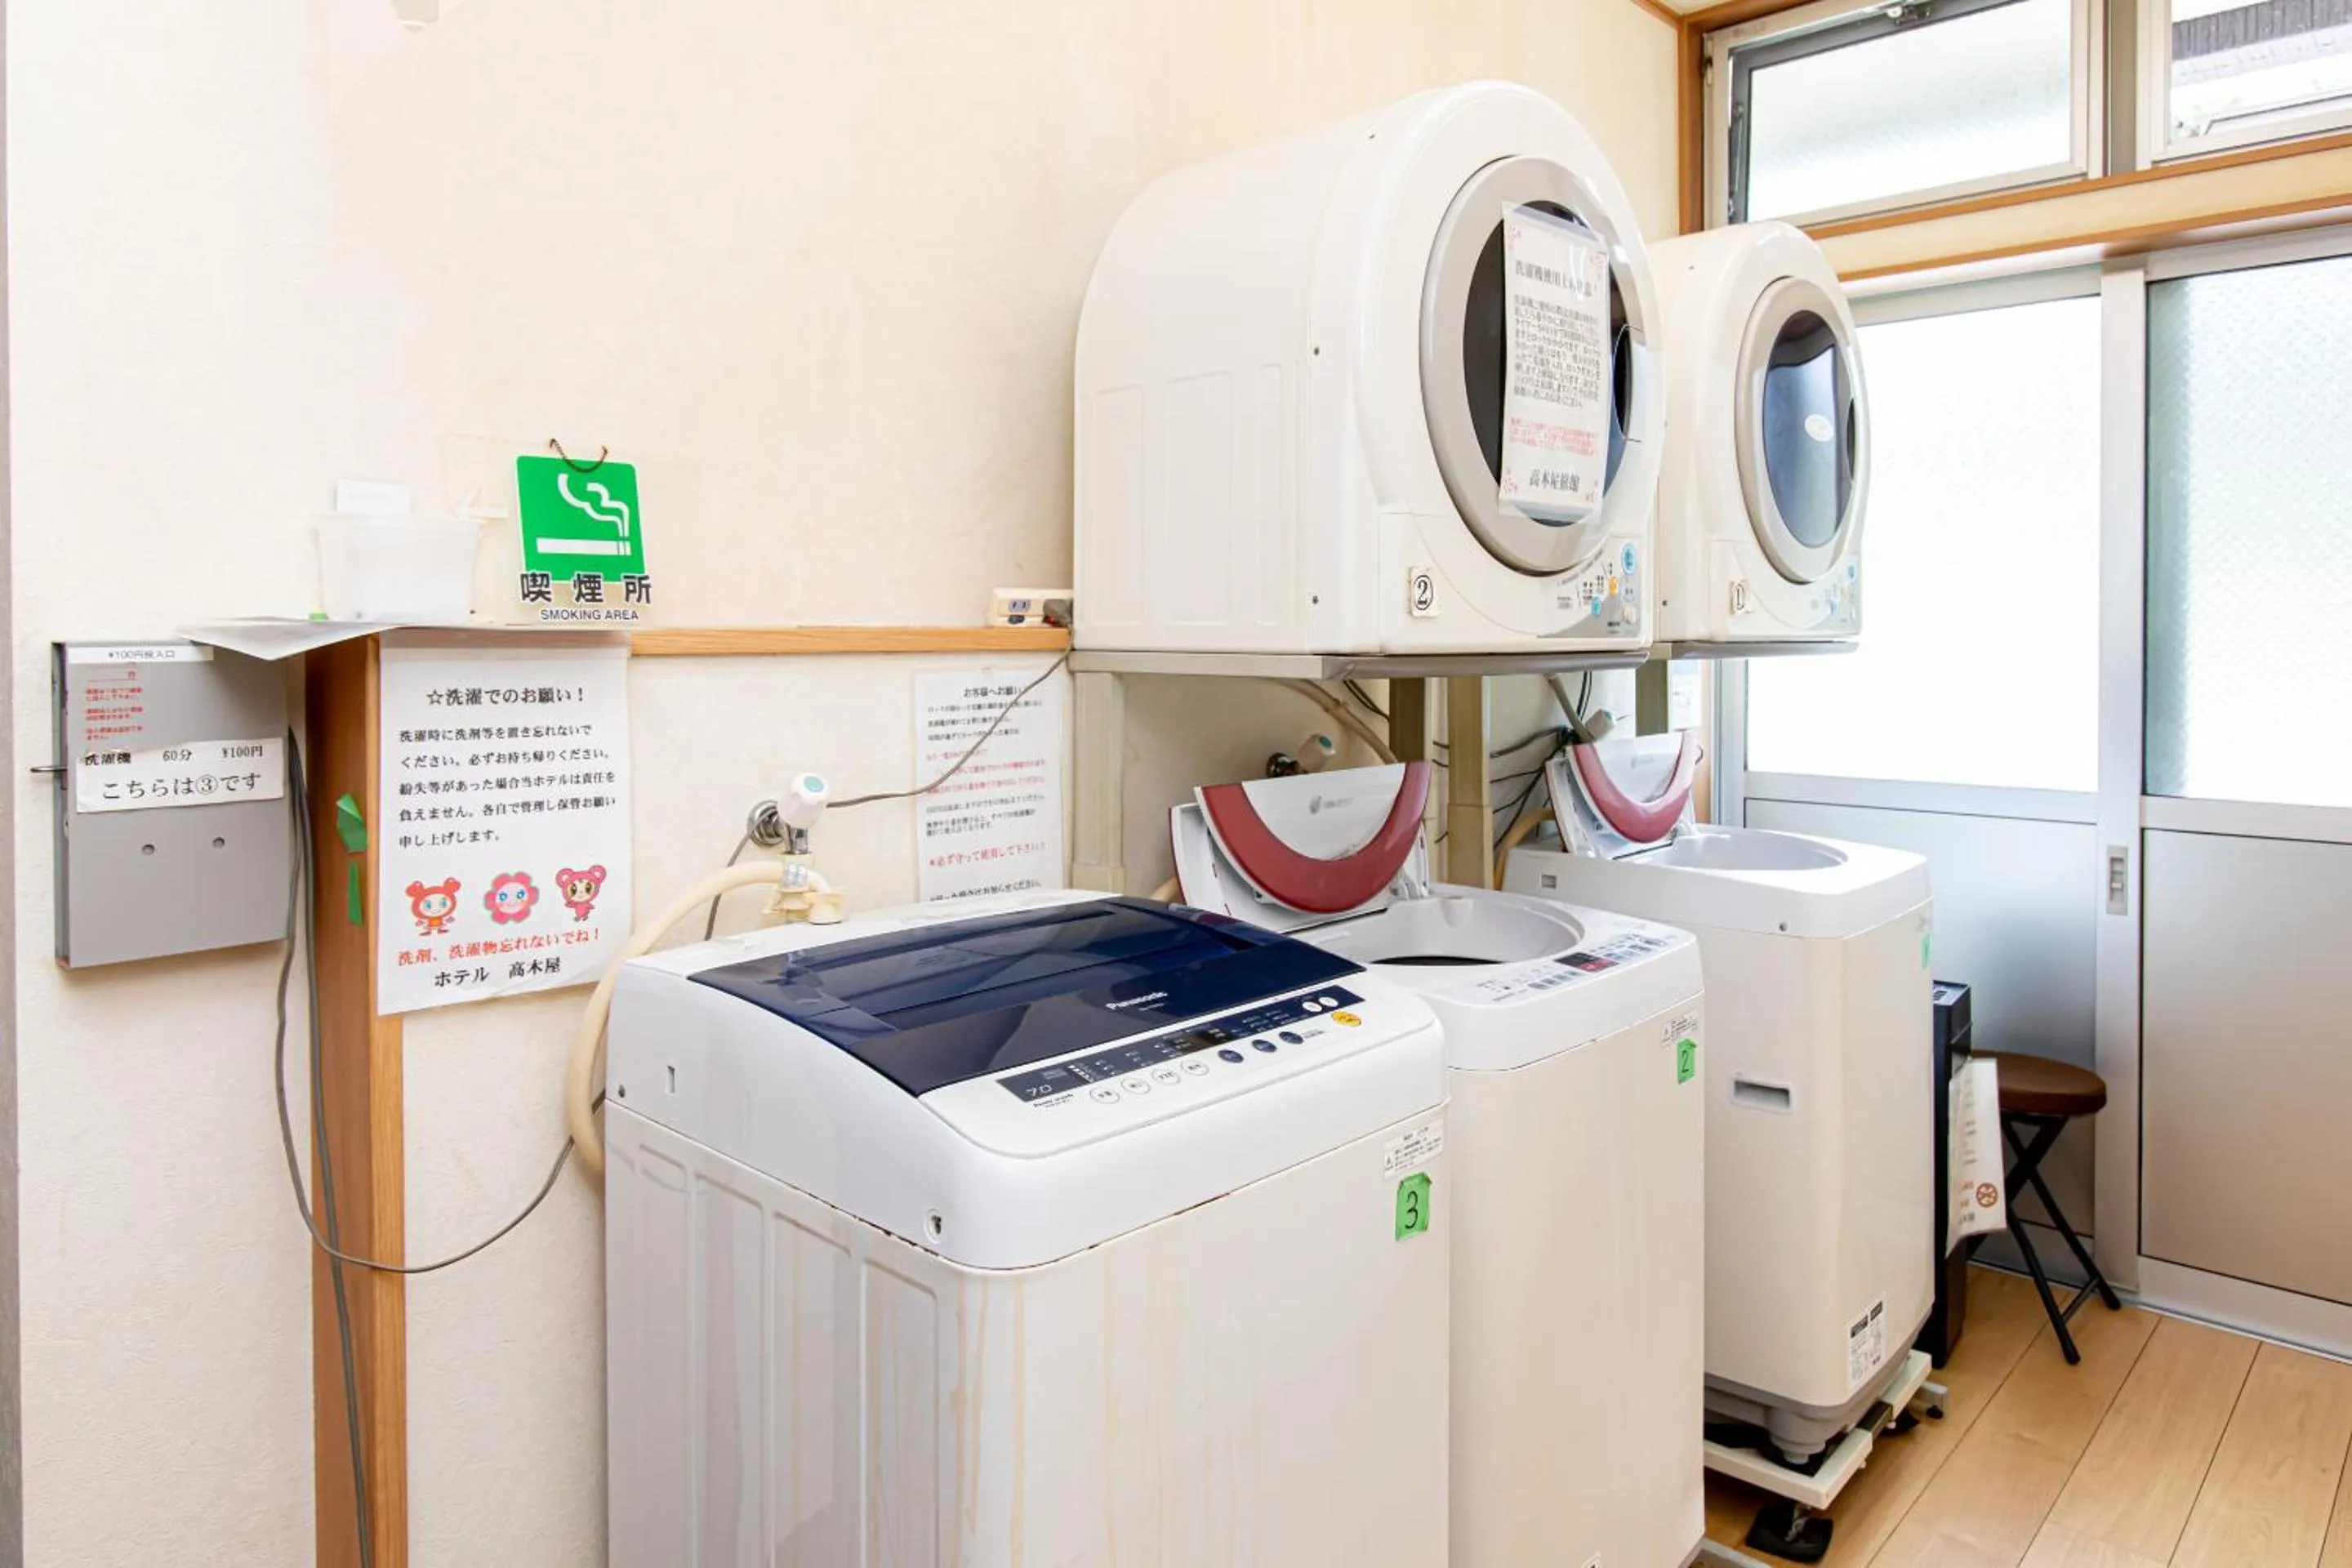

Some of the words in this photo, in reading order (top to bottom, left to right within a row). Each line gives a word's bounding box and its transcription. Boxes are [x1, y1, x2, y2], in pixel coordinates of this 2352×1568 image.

[520, 572, 651, 604] 喫煙所
[541, 609, 601, 621] SMOKING
[604, 608, 639, 620] AREA
[399, 724, 592, 742] 洗濯時に洗剤等を置き忘れないで
[84, 751, 131, 766] 洗濯機
[163, 749, 193, 761] 60分
[399, 771, 616, 795] 紛失等があった場合当ホテルは責任を
[399, 829, 500, 849] 申し上げします。
[434, 966, 489, 987] ホテル
[509, 956, 561, 978] 高木屋
[1405, 1191, 1419, 1230] 3
